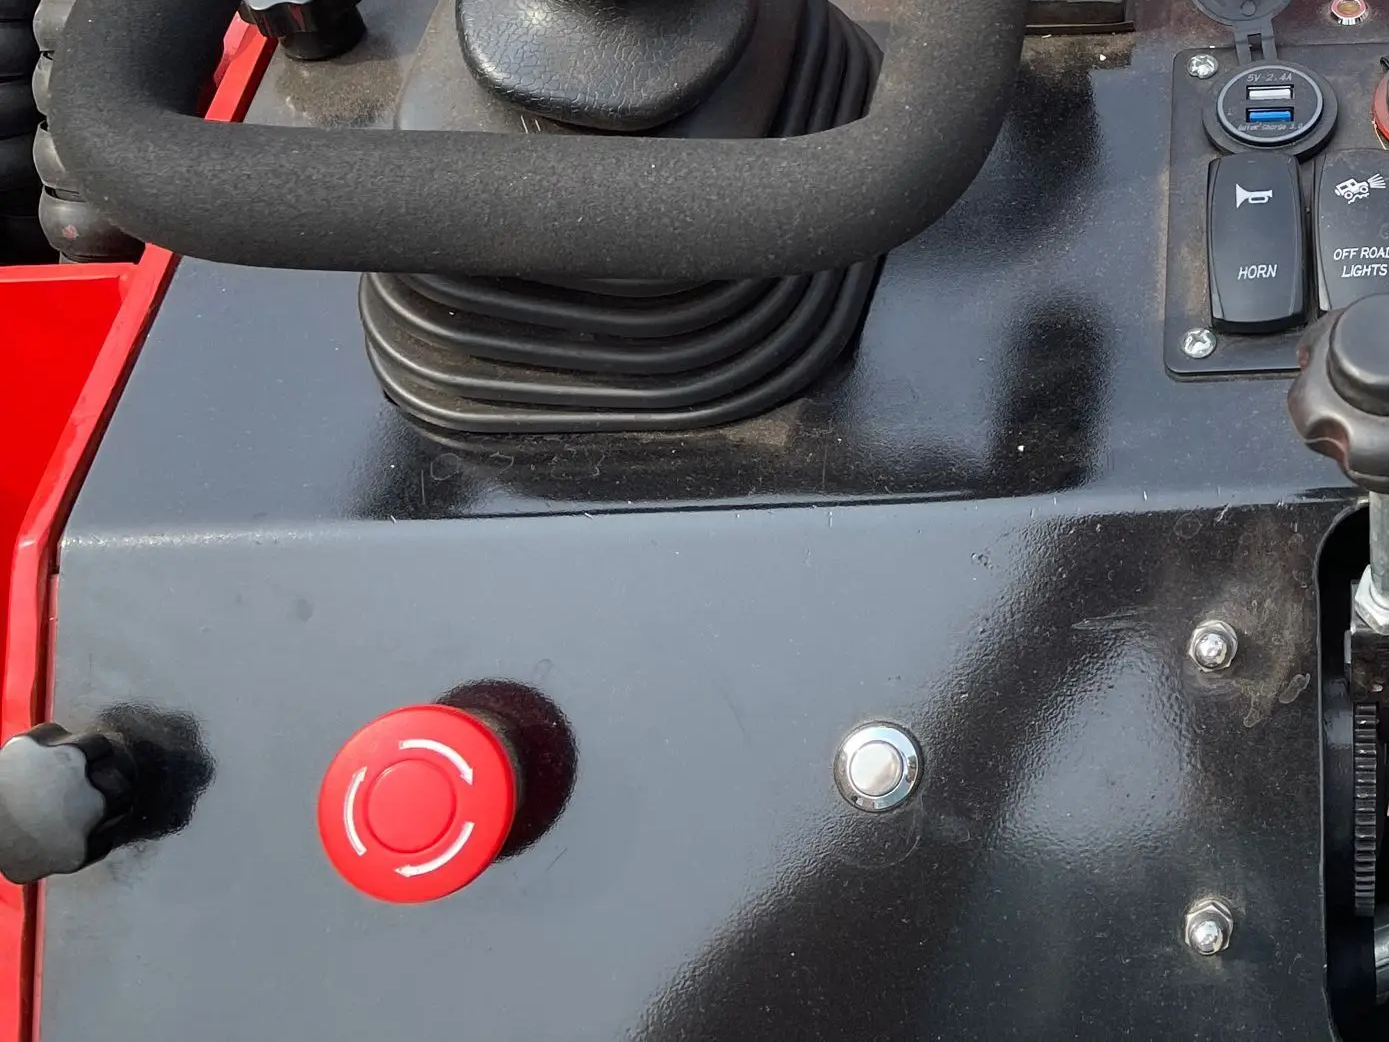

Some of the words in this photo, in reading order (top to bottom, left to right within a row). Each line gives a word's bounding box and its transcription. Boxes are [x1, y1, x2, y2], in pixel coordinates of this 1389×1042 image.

[1333, 247, 1358, 260] OFF
[1237, 264, 1277, 280] HORN
[1341, 263, 1388, 278] LIGHTS
